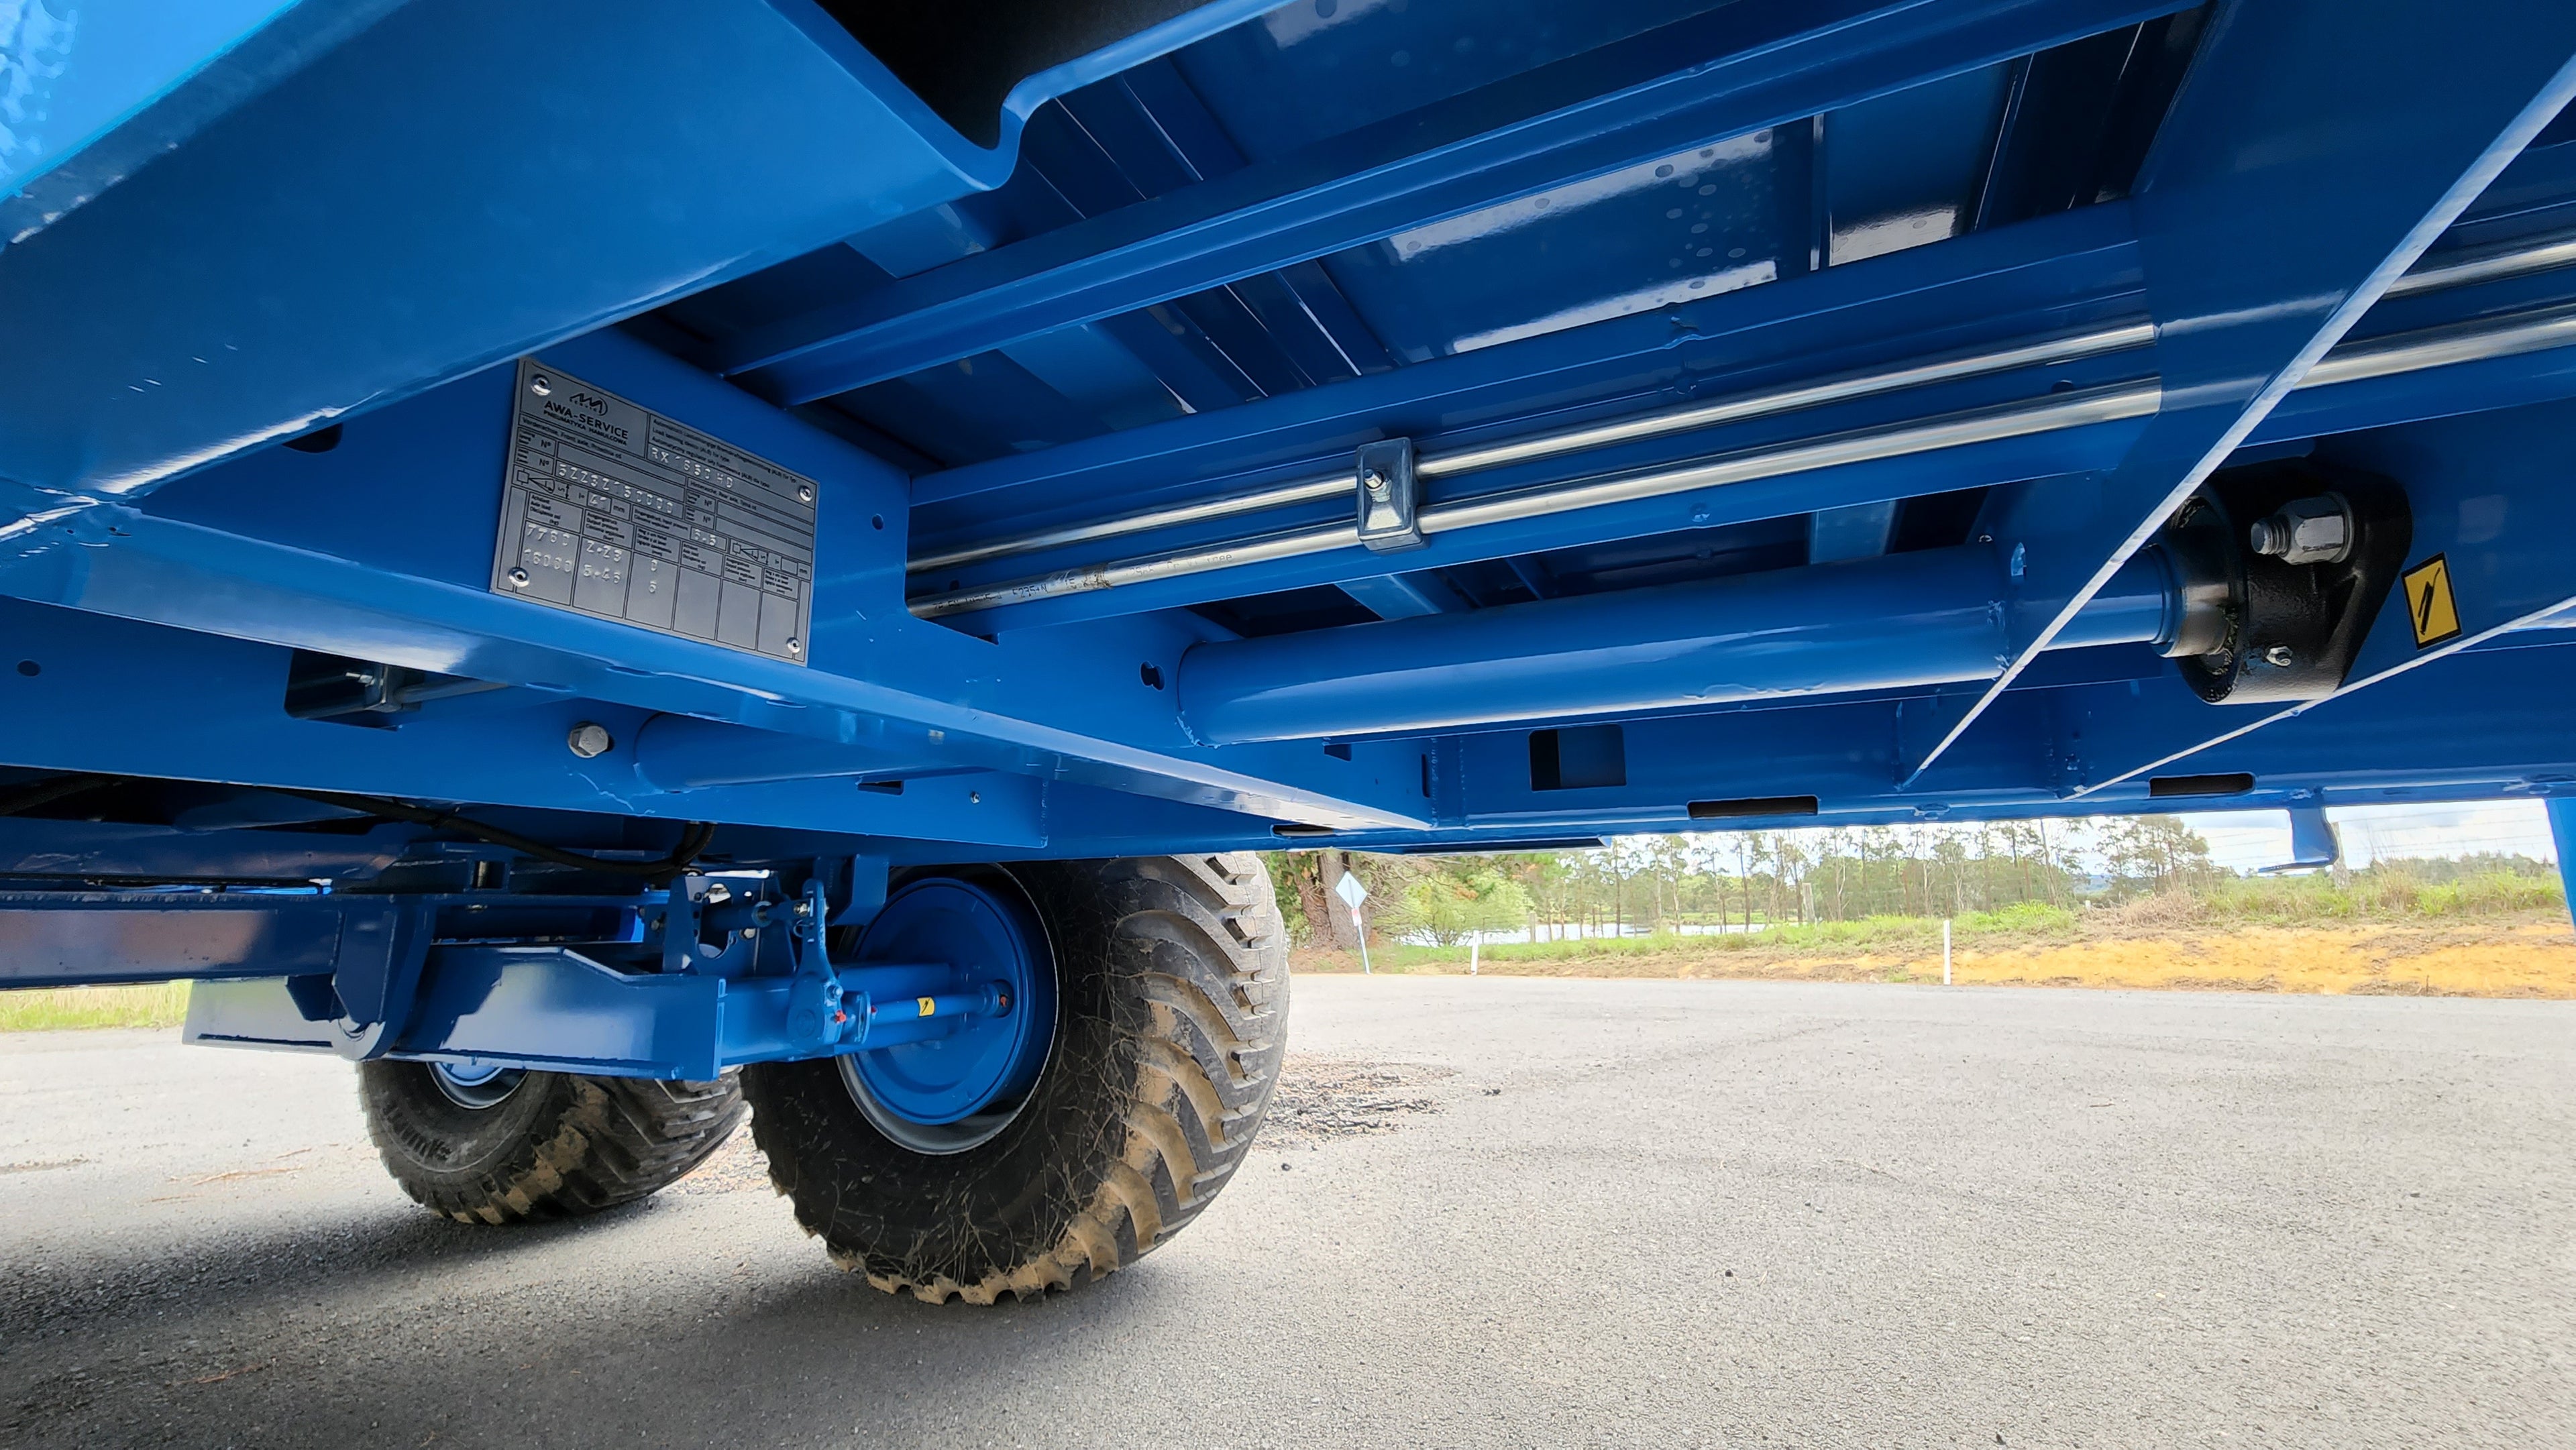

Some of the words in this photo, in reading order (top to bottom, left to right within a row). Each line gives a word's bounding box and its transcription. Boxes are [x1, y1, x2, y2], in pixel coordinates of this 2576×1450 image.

[544, 398, 628, 439] AWA-SERVICE
[651, 446, 669, 463] RX
[613, 504, 625, 513] mm
